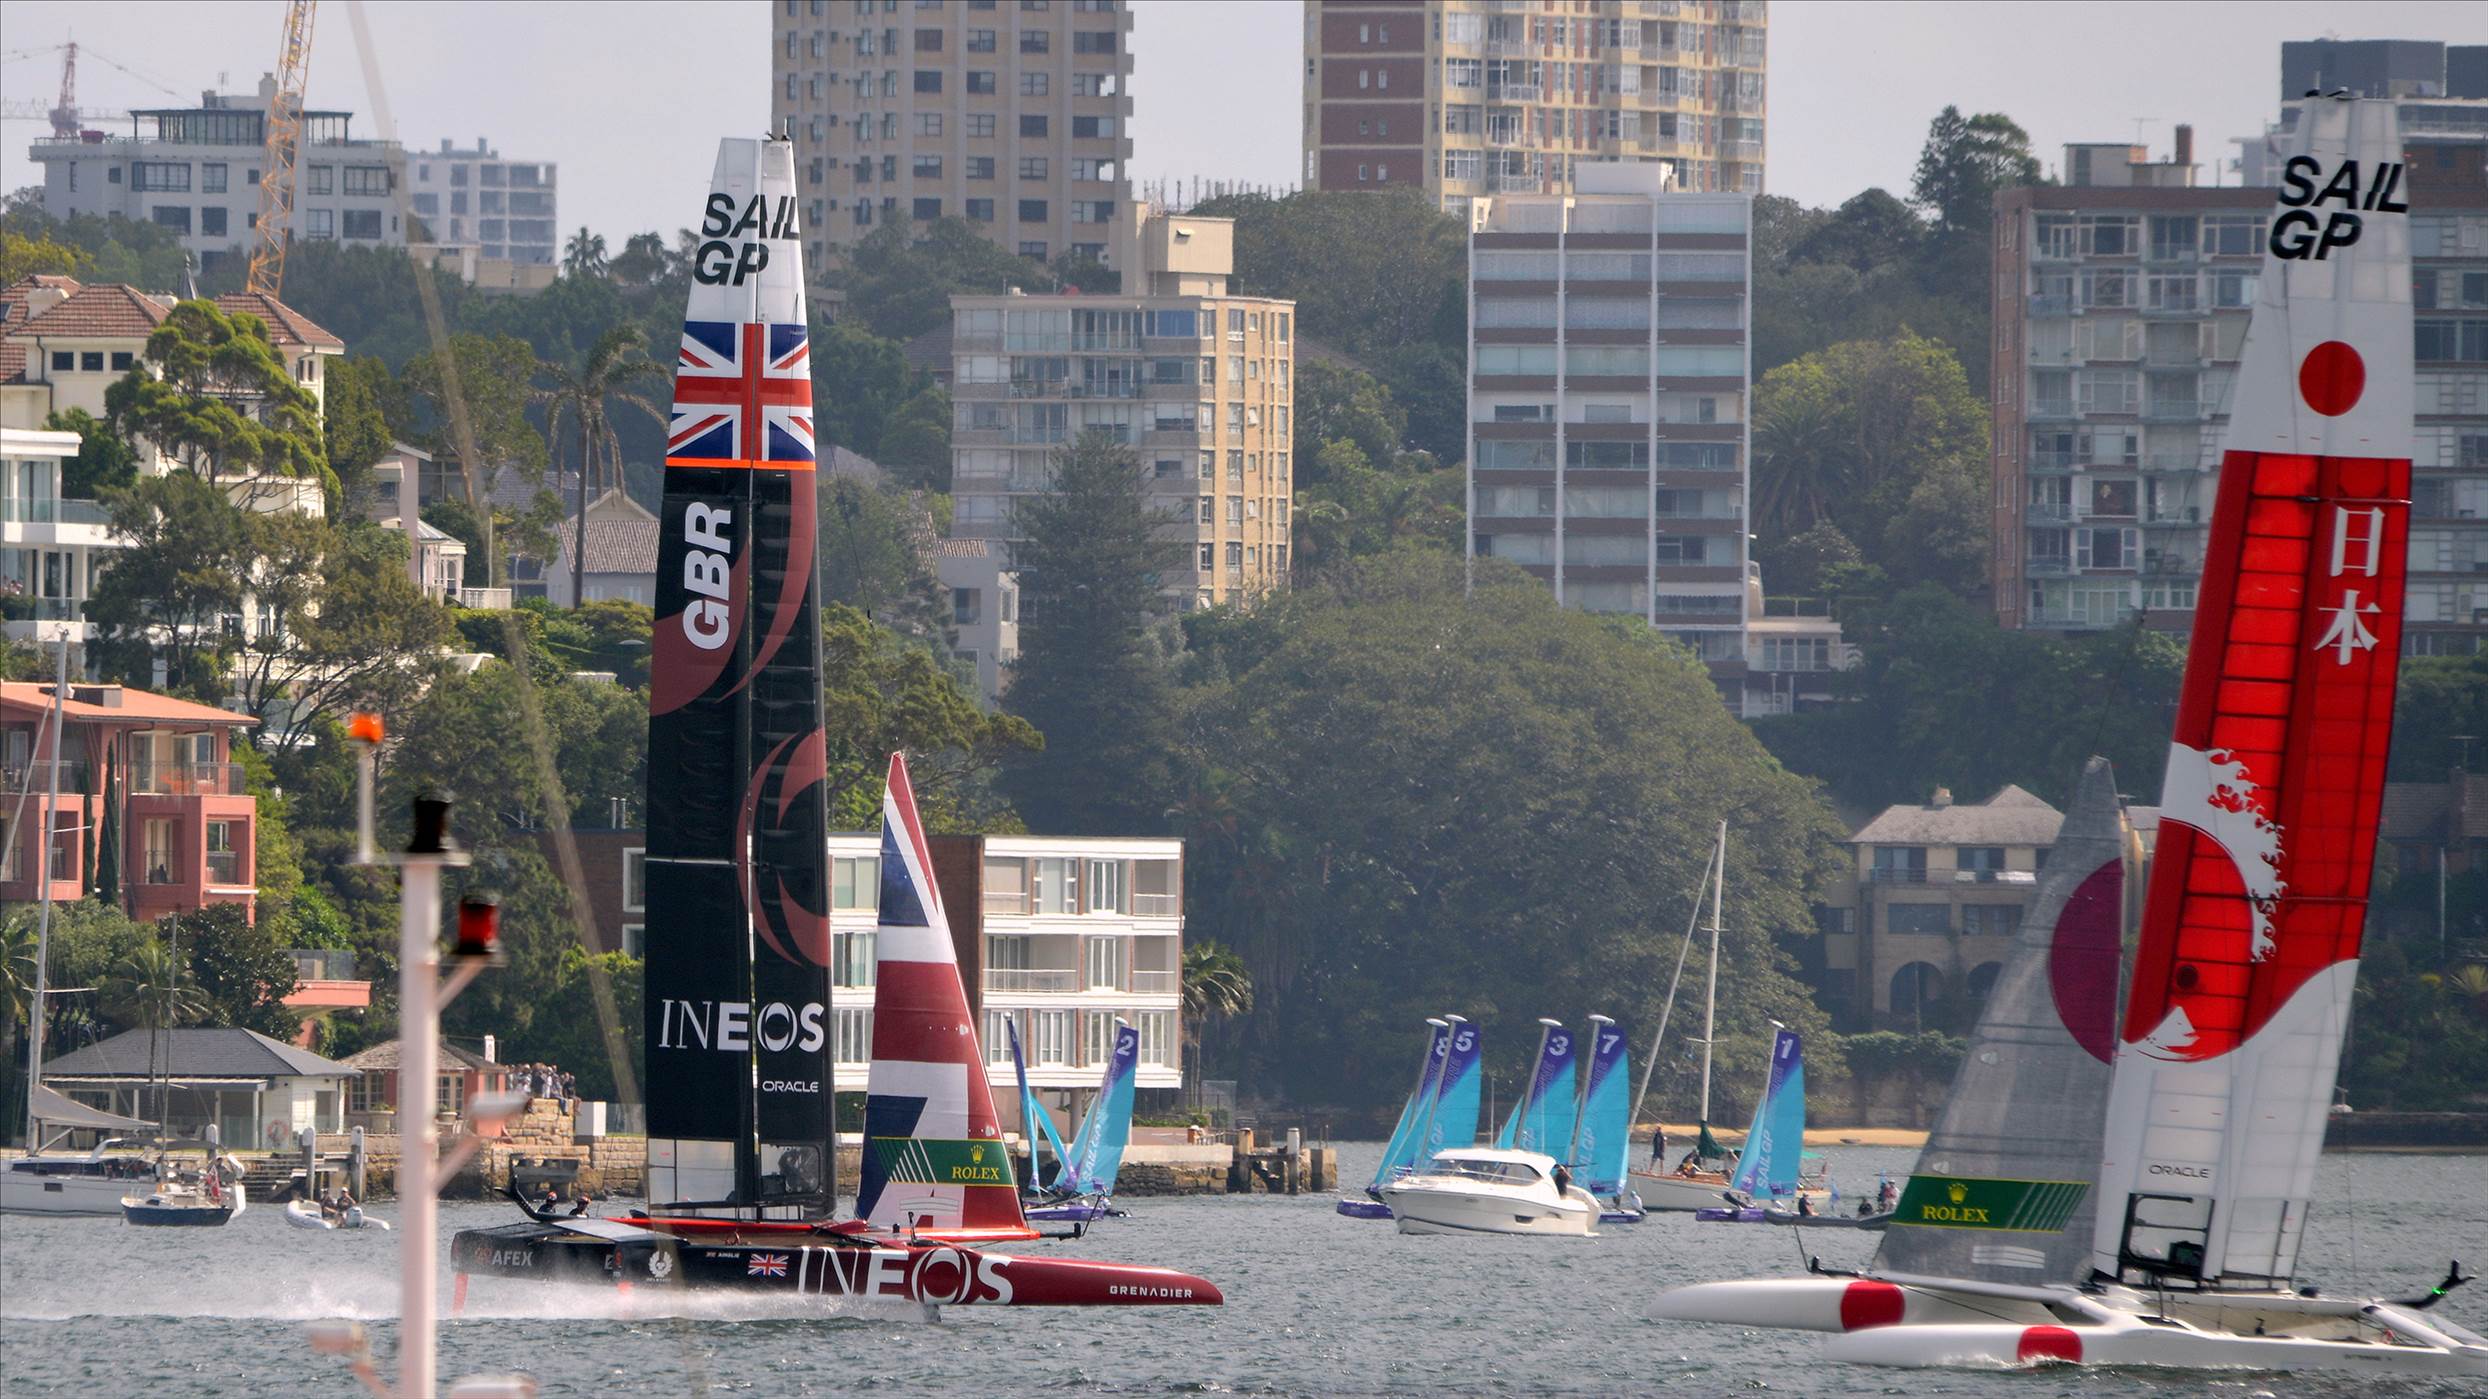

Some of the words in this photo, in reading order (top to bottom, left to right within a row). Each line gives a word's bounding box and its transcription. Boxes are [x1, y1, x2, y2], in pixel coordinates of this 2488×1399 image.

[2279, 155, 2408, 213] SAIL
[702, 193, 801, 240] SAIL
[2270, 209, 2363, 260] GP
[693, 240, 769, 287] GP
[682, 501, 733, 650] GBR
[2314, 505, 2386, 666] 日本
[658, 999, 824, 1052] INEOS
[1116, 1035, 1135, 1056] 2
[1455, 1030, 1475, 1053] 5
[1549, 1035, 1569, 1056] 3
[1602, 1034, 1620, 1054] 7
[1780, 1038, 1794, 1060] 1
[762, 1080, 819, 1094] ORACLE
[1762, 1130, 1775, 1152] GP
[951, 1165, 999, 1181] ROLEX
[1755, 1154, 1773, 1189] SAIL
[2149, 1164, 2209, 1179] ORACLE
[1922, 1205, 1989, 1224] ROLEX
[492, 1251, 533, 1267] AFEX
[798, 1246, 1014, 1305] INEOS
[1109, 1285, 1193, 1299] GRENADIER
